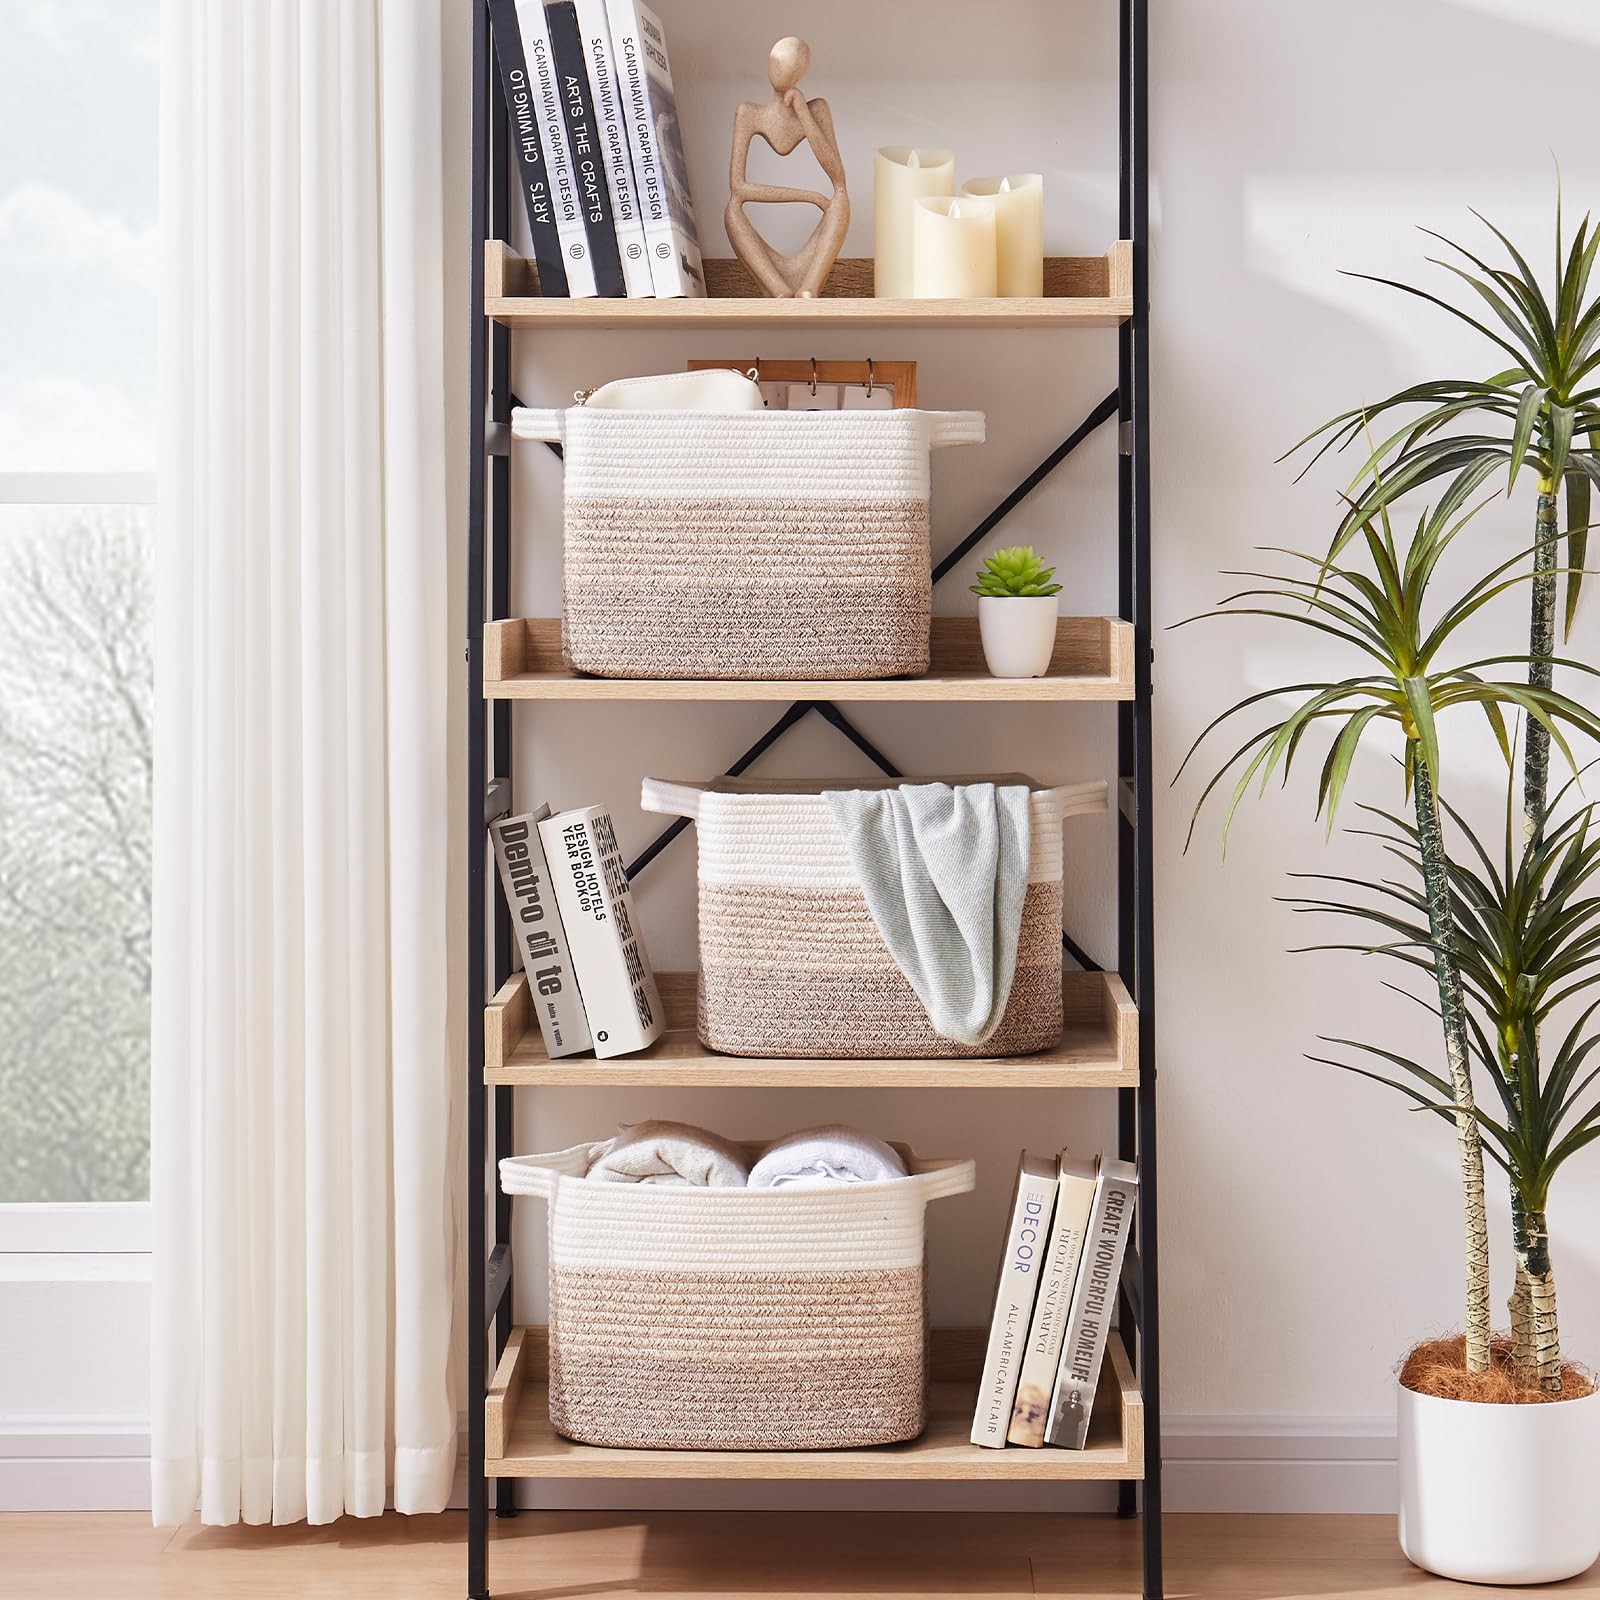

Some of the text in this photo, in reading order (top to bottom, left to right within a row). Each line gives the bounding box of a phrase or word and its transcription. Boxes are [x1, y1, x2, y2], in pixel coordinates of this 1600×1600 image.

[510, 69, 550, 223] ARTS CHI WING LO
[533, 39, 576, 221] SCANDINAVIAV GRAPHIC DESIGN
[565, 74, 603, 224] ARTS THE CRAFTS
[591, 38, 633, 221] SCANDINAVIAV GRAPHIC DESIGN
[622, 37, 663, 220] SCANDINAVIAV GRAPHIC DESIGN
[500, 821, 545, 924] Dentro
[562, 825, 579, 859] YEAR
[573, 823, 594, 869] DESIGN
[585, 872, 607, 921] HOTELS
[526, 930, 559, 960] di
[535, 964, 563, 997] te
[1014, 1202, 1042, 1274] DECOR
[1036, 1228, 1071, 1353] DARWINS TEORI
[1048, 1306, 1063, 1356] EVOLUSJON
[1069, 1243, 1077, 1259] 400
[1070, 1190, 1126, 1383] CREATE WONDERFUL HOMELIFE
[987, 1303, 1019, 1434] ALL-AMERICAN FLAIR
